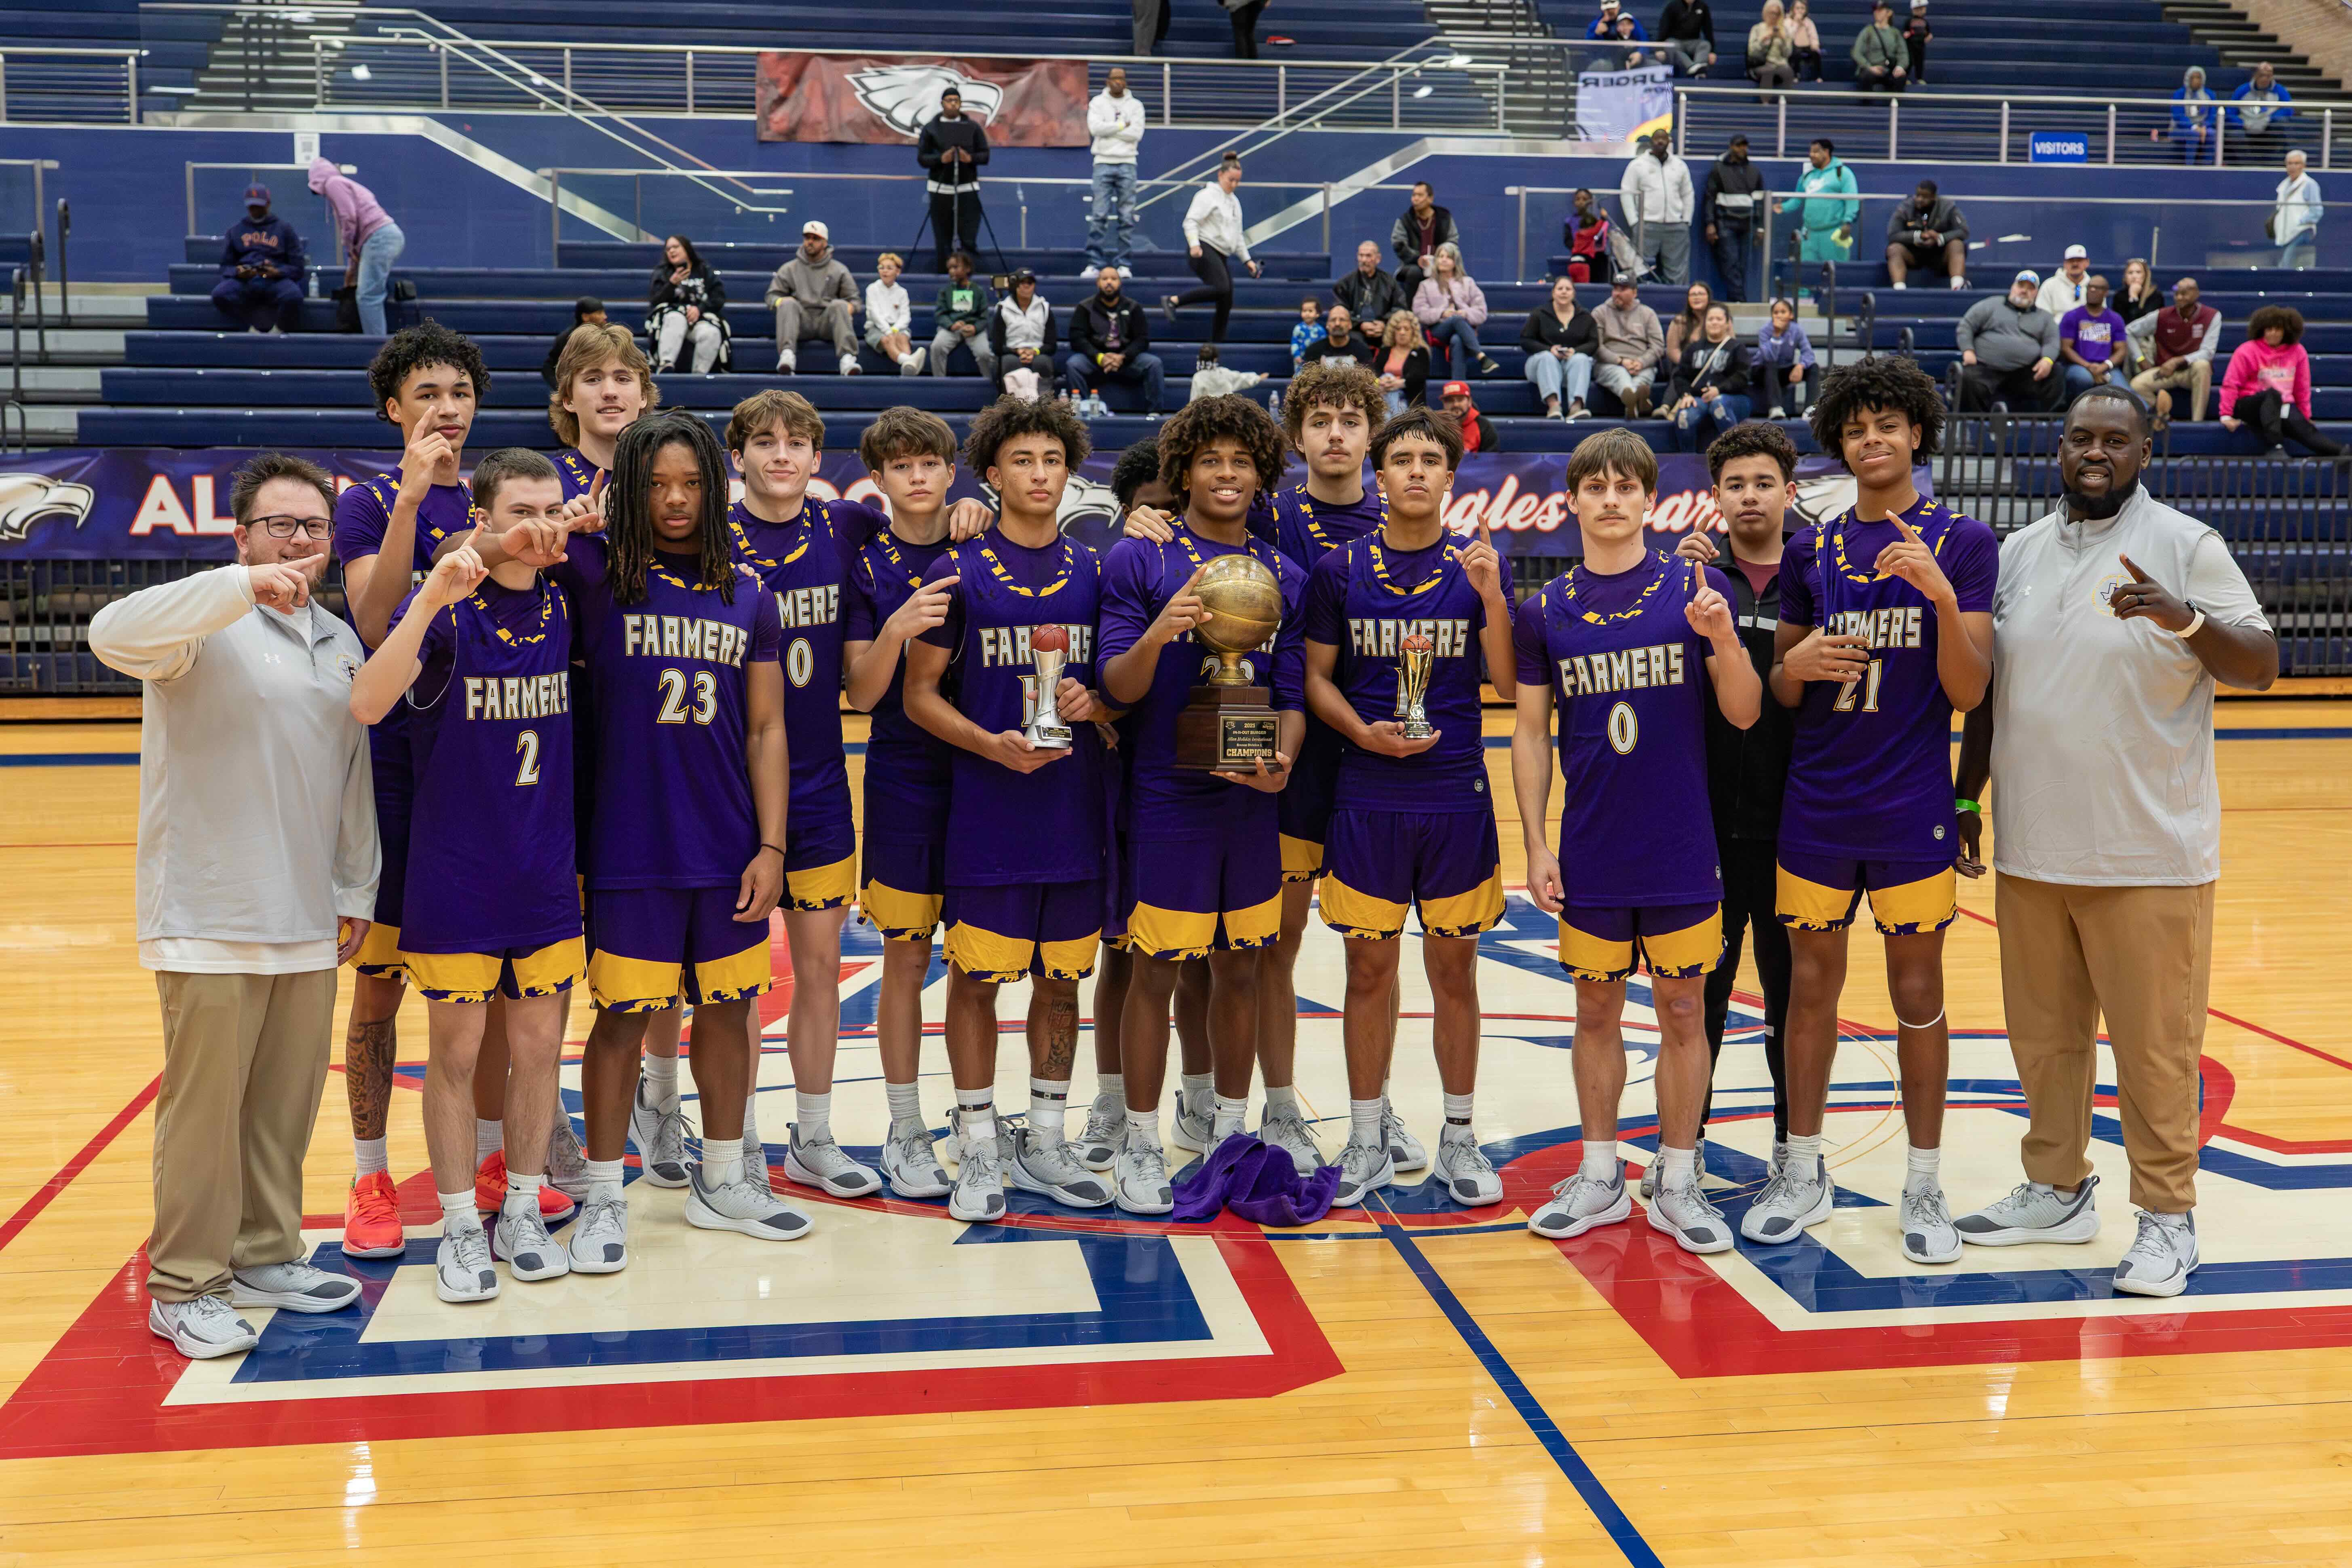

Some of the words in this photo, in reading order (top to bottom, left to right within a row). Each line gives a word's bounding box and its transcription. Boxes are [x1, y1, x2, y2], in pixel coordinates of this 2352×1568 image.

[2034, 141, 2084, 155] VISITORS
[241, 232, 279, 247] POLO
[1440, 474, 1567, 538] gles
[774, 584, 839, 629] MERS
[623, 614, 748, 668] FARMERS
[787, 637, 813, 688] 0
[979, 624, 1092, 667] FARRS
[464, 671, 568, 720] FARMERS
[657, 668, 717, 725] 23
[1558, 643, 1684, 698] FARMERS
[1608, 701, 1638, 754] 0
[515, 730, 540, 786] 2
